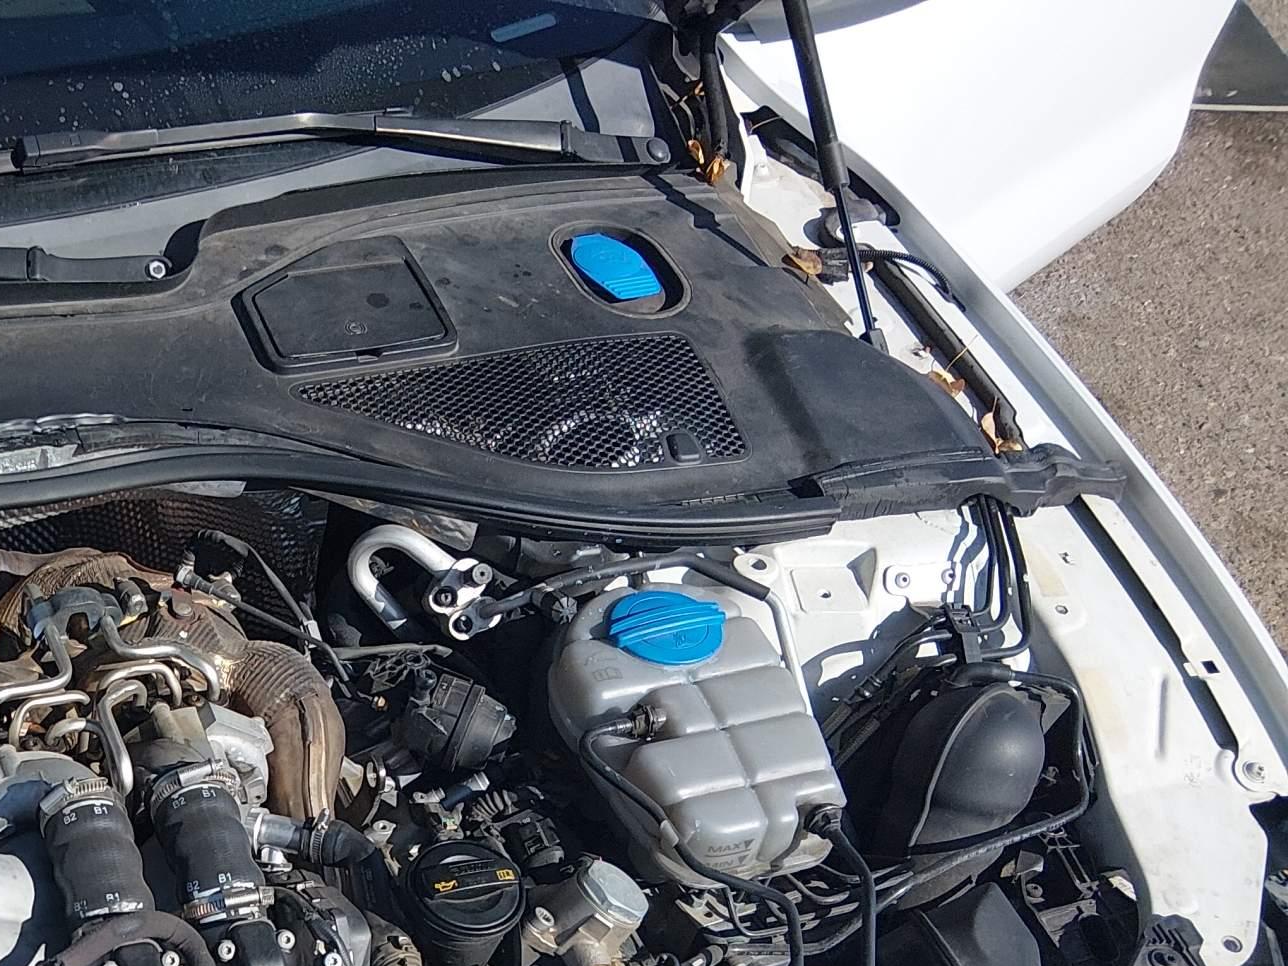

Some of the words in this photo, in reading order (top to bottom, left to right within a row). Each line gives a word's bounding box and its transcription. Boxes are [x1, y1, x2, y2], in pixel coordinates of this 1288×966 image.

[201, 789, 217, 798] B1
[172, 796, 186, 809] B2
[93, 806, 108, 815] B1
[63, 812, 78, 825] B2
[707, 842, 742, 853] MAX
[218, 872, 232, 883] B1
[186, 880, 200, 892] B2
